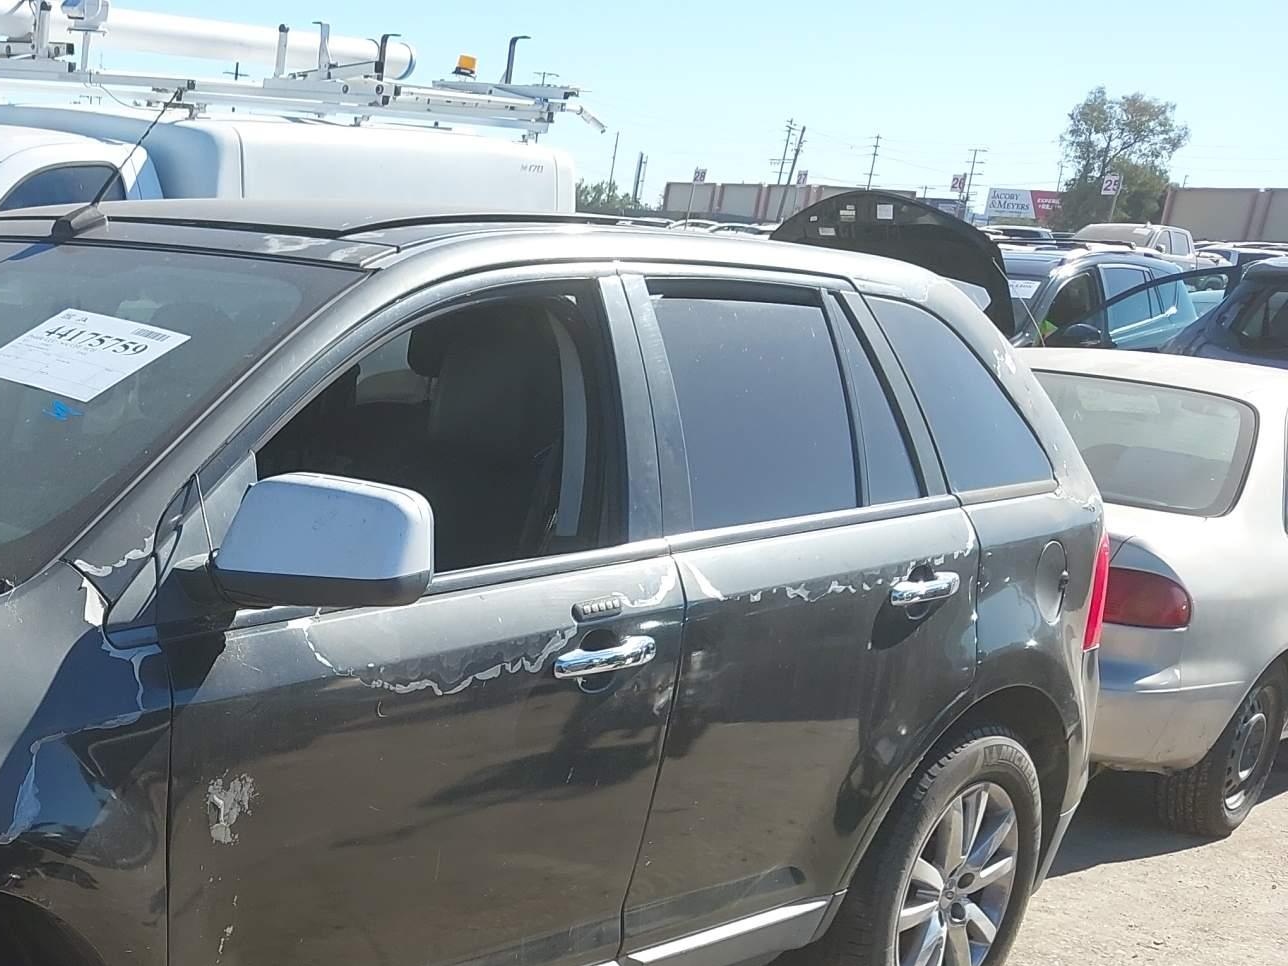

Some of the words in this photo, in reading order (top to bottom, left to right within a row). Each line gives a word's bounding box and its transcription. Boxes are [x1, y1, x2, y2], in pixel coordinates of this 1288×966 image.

[694, 171, 706, 182] 28
[1103, 179, 1119, 192] 25
[991, 190, 1020, 201] JACOBY
[45, 325, 149, 356] 44175759
